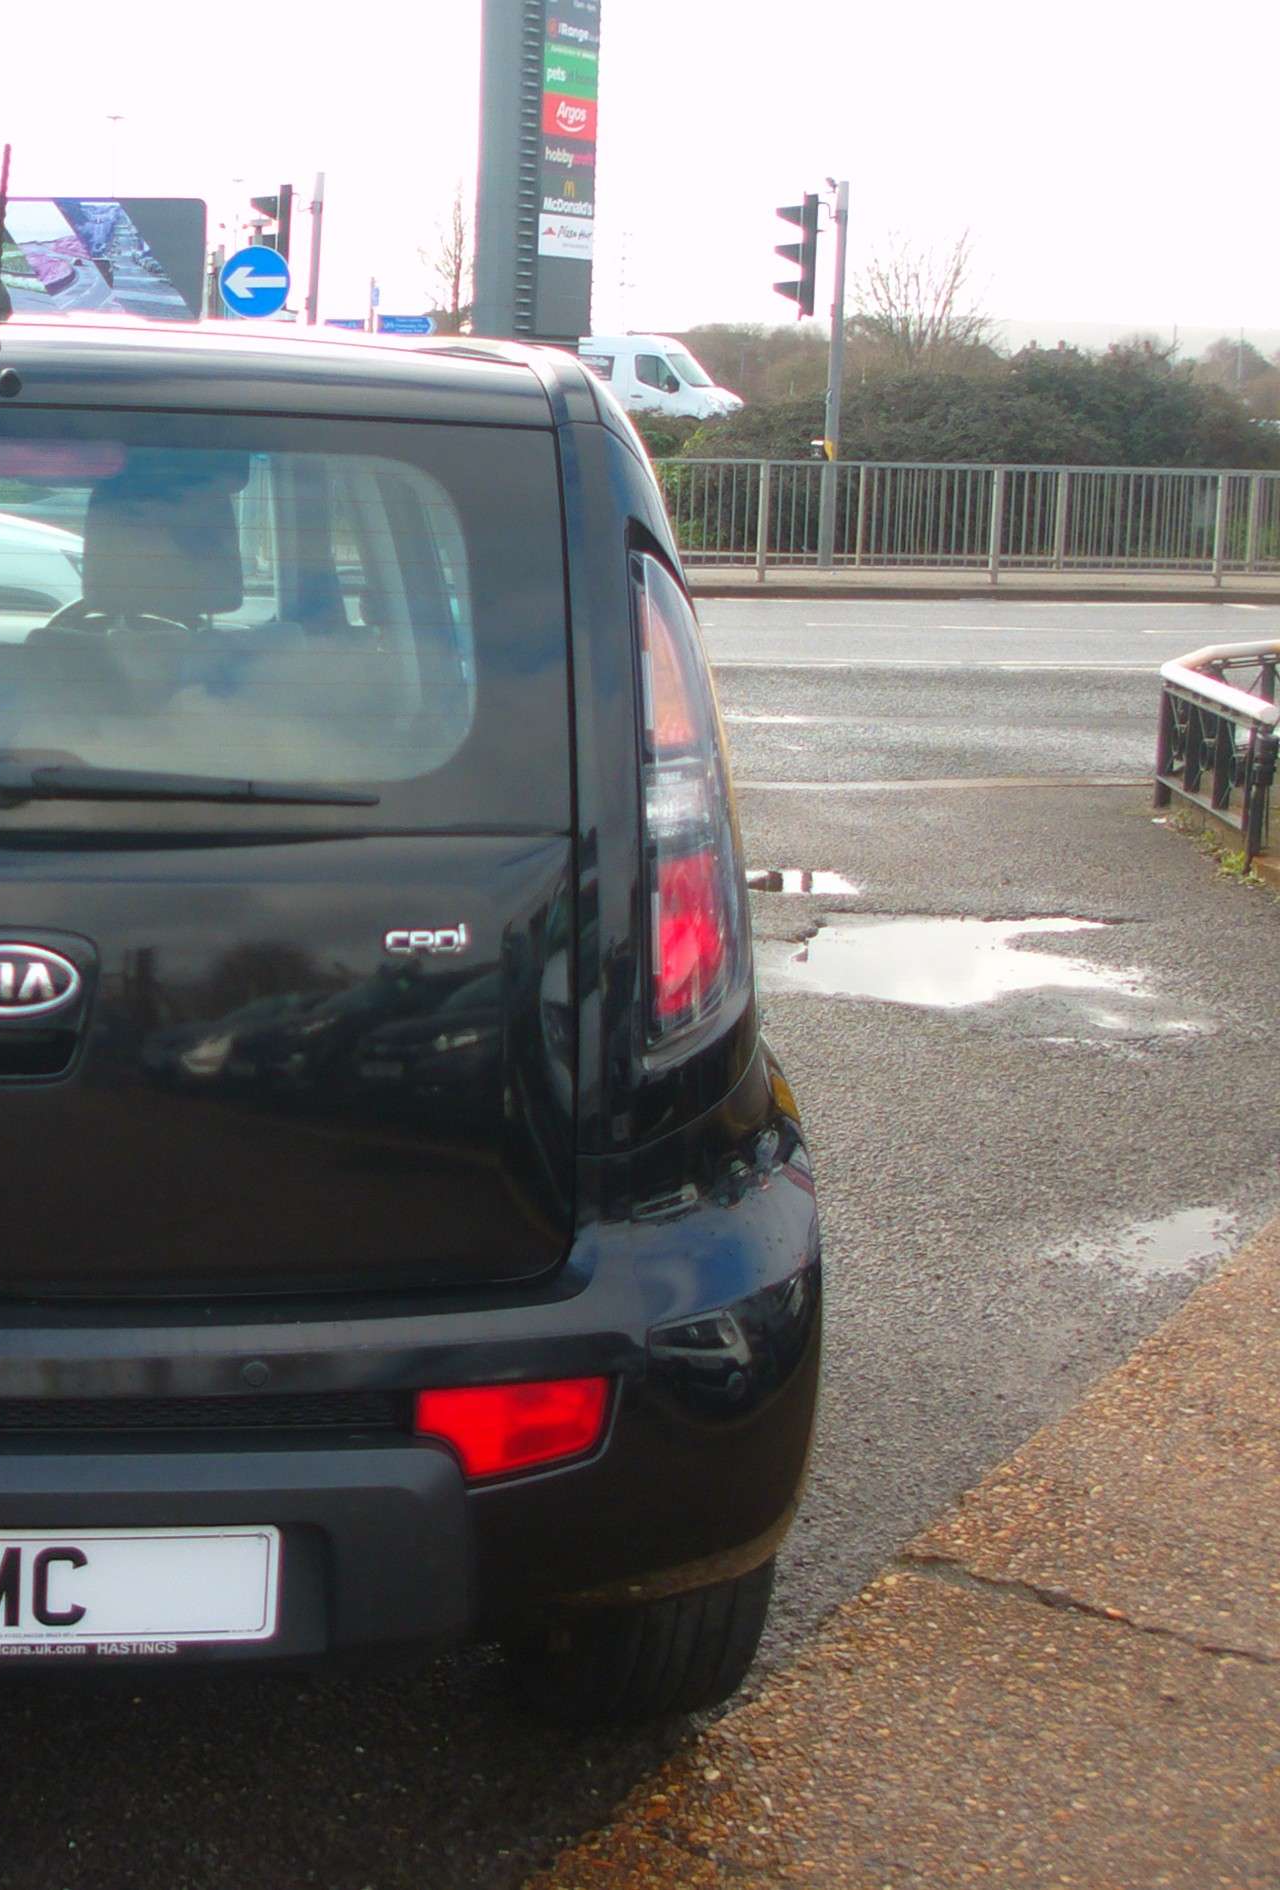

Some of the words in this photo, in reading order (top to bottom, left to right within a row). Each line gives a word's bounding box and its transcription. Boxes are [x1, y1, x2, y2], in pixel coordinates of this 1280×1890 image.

[556, 101, 587, 125] Argos
[543, 196, 593, 217] McDonald's
[96, 1641, 178, 1655] HASTINGS
